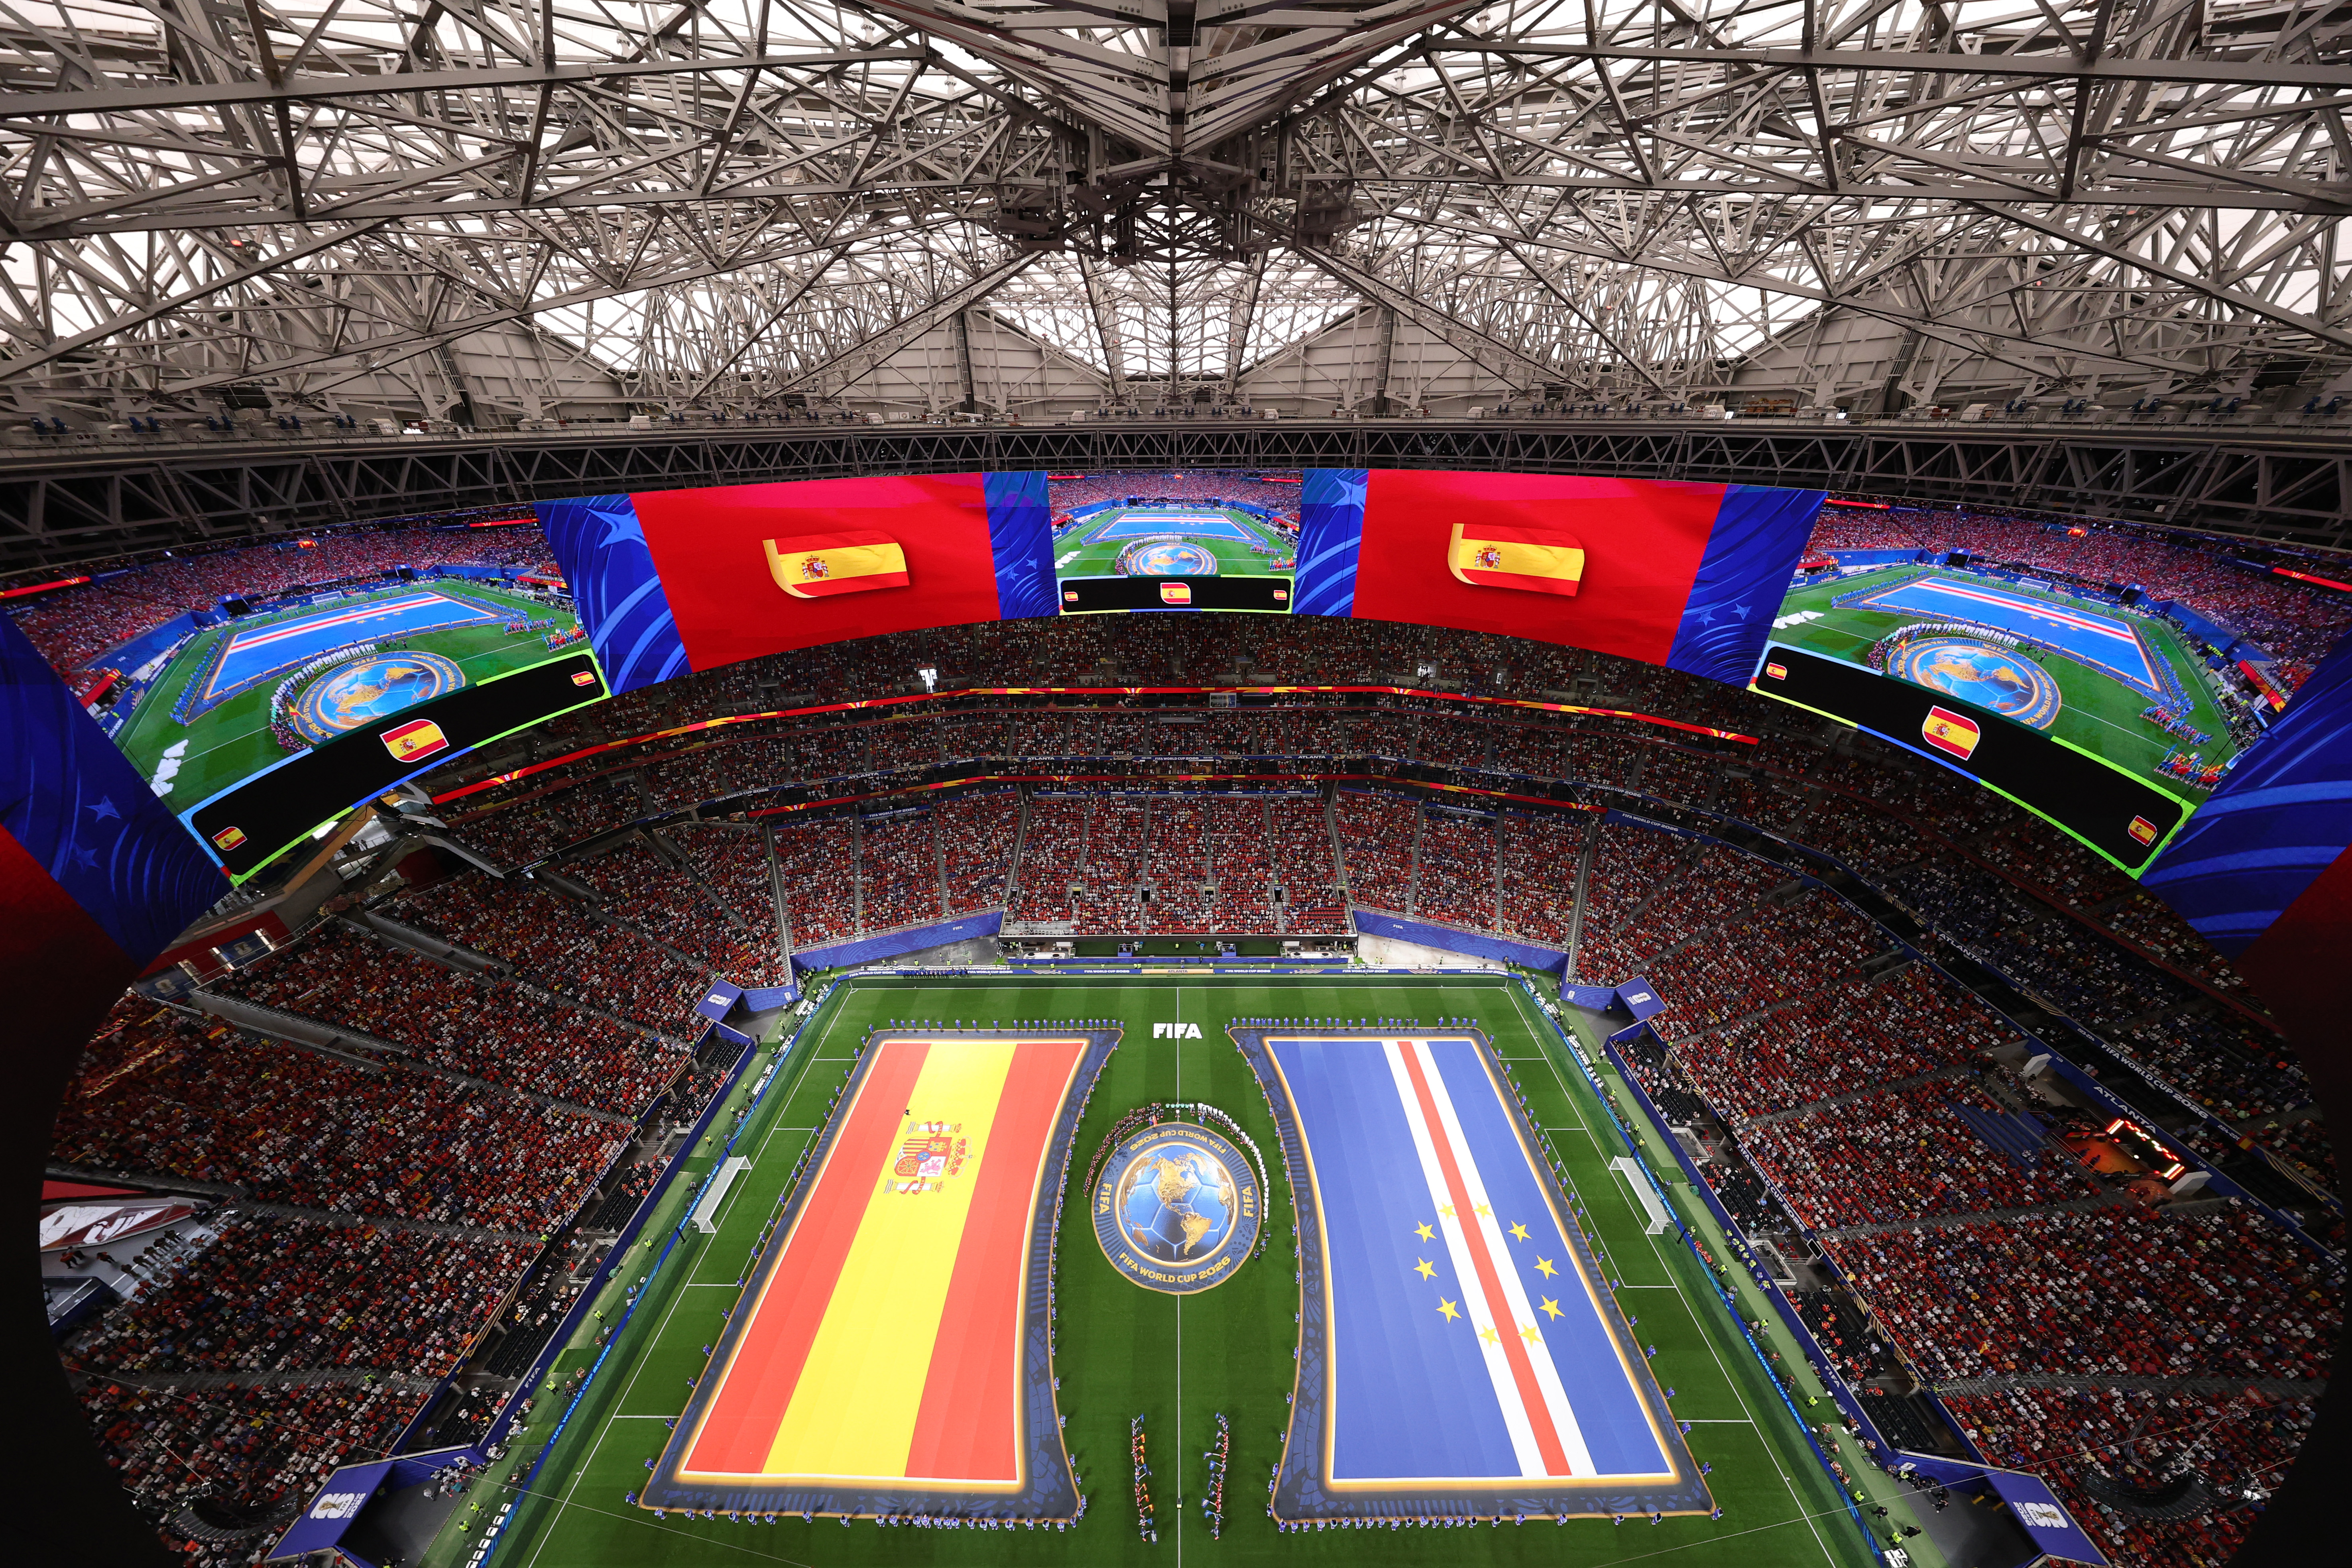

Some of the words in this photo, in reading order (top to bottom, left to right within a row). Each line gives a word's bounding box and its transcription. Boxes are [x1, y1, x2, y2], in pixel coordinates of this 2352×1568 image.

[1982, 643, 2009, 654] FIFA
[352, 656, 377, 666] FIFA
[433, 660, 446, 668] CUP
[442, 666, 456, 683] WORLD
[312, 681, 326, 693] FIFA
[303, 693, 315, 713] WORLD
[2033, 700, 2052, 719] WORLD
[303, 712, 313, 723] CUP
[1633, 815, 1651, 824] WORLD
[1660, 822, 1679, 832] 2026
[1939, 933, 1982, 965] ATLANTA
[1152, 1022, 1202, 1039] FIFA
[765, 1079, 773, 1089] FIFA
[770, 1064, 780, 1081] WORLD
[783, 1043, 793, 1057] 2026
[1569, 1045, 1579, 1060] WORLD
[1581, 1067, 1592, 1083] 2026
[727, 1073, 735, 1085] FIFA
[1624, 1069, 1632, 1082] FIFA
[2100, 1043, 2120, 1060] FIFA
[2120, 1057, 2153, 1083] WORLD
[2153, 1080, 2173, 1094] CUP
[2172, 1093, 2209, 1119] 2026
[2093, 1086, 2157, 1134] ATLANTA
[1129, 1132, 1158, 1151] 2026
[1158, 1130, 1176, 1139] CUP
[1177, 1131, 1209, 1144] WORLD
[1209, 1139, 1227, 1155] FIFA
[579, 1181, 600, 1208] WORLD
[598, 1163, 612, 1182] CUP
[610, 1140, 630, 1166] 2026
[679, 1216, 688, 1230] FIFA
[687, 1197, 700, 1217] WORLD
[698, 1184, 708, 1199] CUP
[706, 1163, 720, 1185] 2026
[1636, 1155, 1646, 1169] FIFA
[1644, 1168, 1658, 1188] WORLD
[1656, 1186, 1666, 1201] CUP
[1663, 1200, 1677, 1221] 2026
[1737, 1143, 1750, 1159] FIFA
[1750, 1159, 1771, 1187] WORLD
[1770, 1185, 1784, 1204] CUP
[1782, 1201, 1807, 1232] 2026
[1098, 1183, 1114, 1214] FIFA
[1241, 1186, 1255, 1218] FIFA
[1118, 1252, 1139, 1272] FIFA
[1138, 1265, 1176, 1283] WORLD
[1176, 1273, 1198, 1283] CUP
[1198, 1255, 1232, 1279] 2026
[524, 1366, 541, 1389] FIFA
[1746, 1334, 1758, 1353] FIFA
[1757, 1350, 1778, 1383] WORLD
[1775, 1382, 1788, 1401] CUP
[1786, 1400, 1808, 1434] 2026
[1824, 1365, 1841, 1388] FIFA
[550, 1424, 564, 1444] FIFA
[562, 1391, 583, 1423] WORLD
[582, 1372, 594, 1391] CUP
[592, 1344, 612, 1374] 2026
[340, 1499, 350, 1511] FIFA
[342, 1502, 355, 1518] WORLD
[346, 1493, 366, 1518] 2026
[2013, 1501, 2033, 1526] 2026
[2018, 1502, 2031, 1518] WORLD
[2028, 1517, 2037, 1527] CUP
[2030, 1509, 2039, 1520] FIFA
